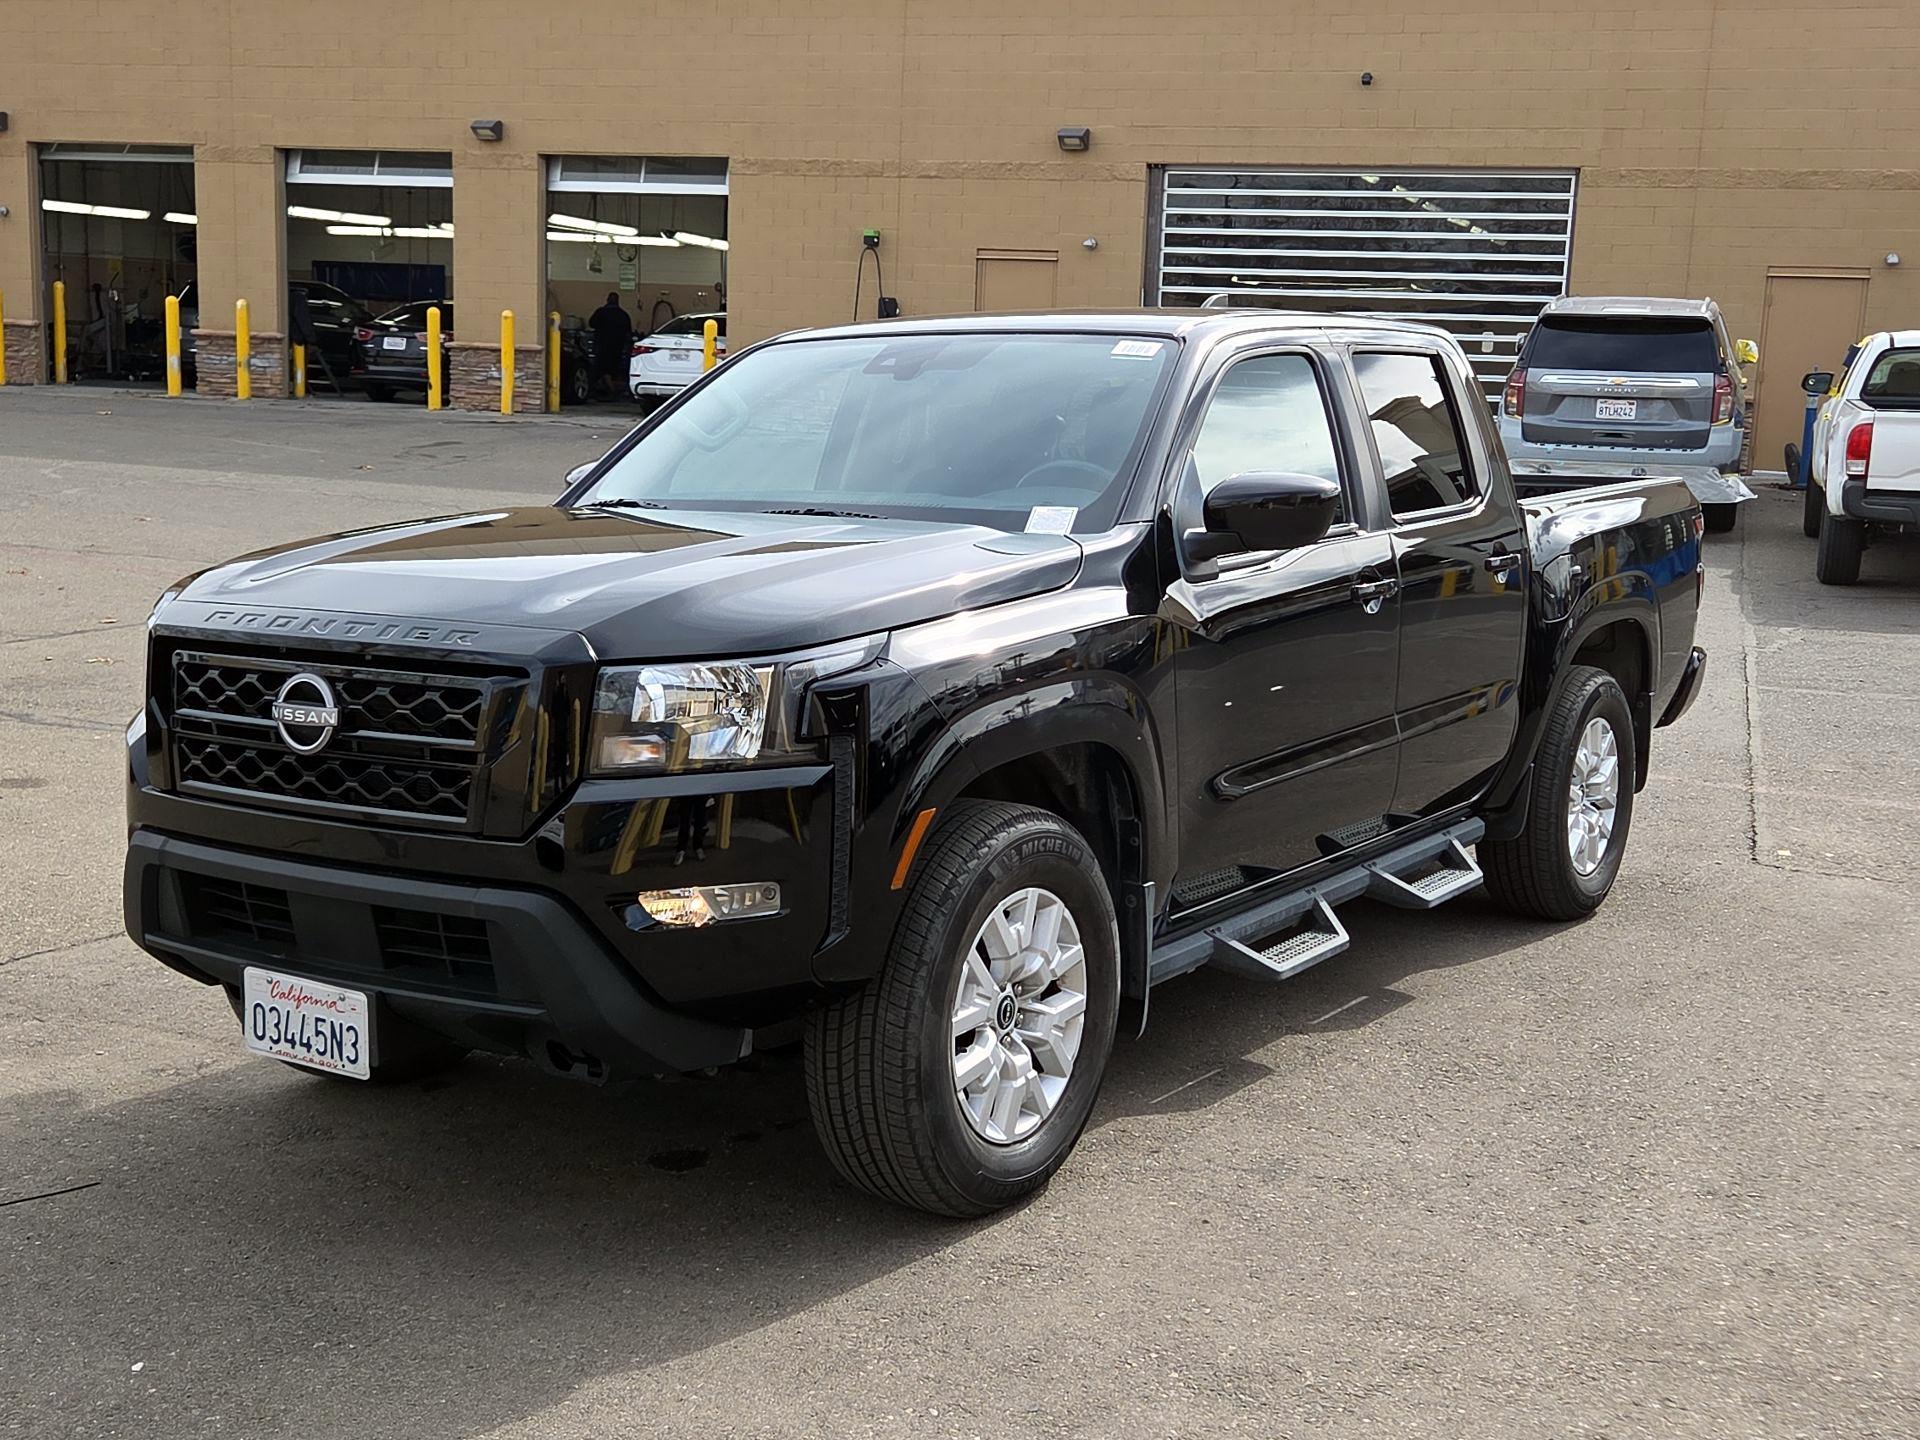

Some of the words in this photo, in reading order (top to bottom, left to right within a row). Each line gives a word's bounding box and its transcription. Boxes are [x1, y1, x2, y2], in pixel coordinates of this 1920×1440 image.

[1598, 406, 1633, 417] 8TLH242
[204, 611, 480, 646] FRONTIER
[271, 706, 335, 724] NISSAN
[1022, 838, 1082, 859] MICHELIN
[270, 980, 346, 1013] California
[253, 1002, 359, 1065] 03445N3
[276, 1049, 339, 1069] dmv.ca.gov
